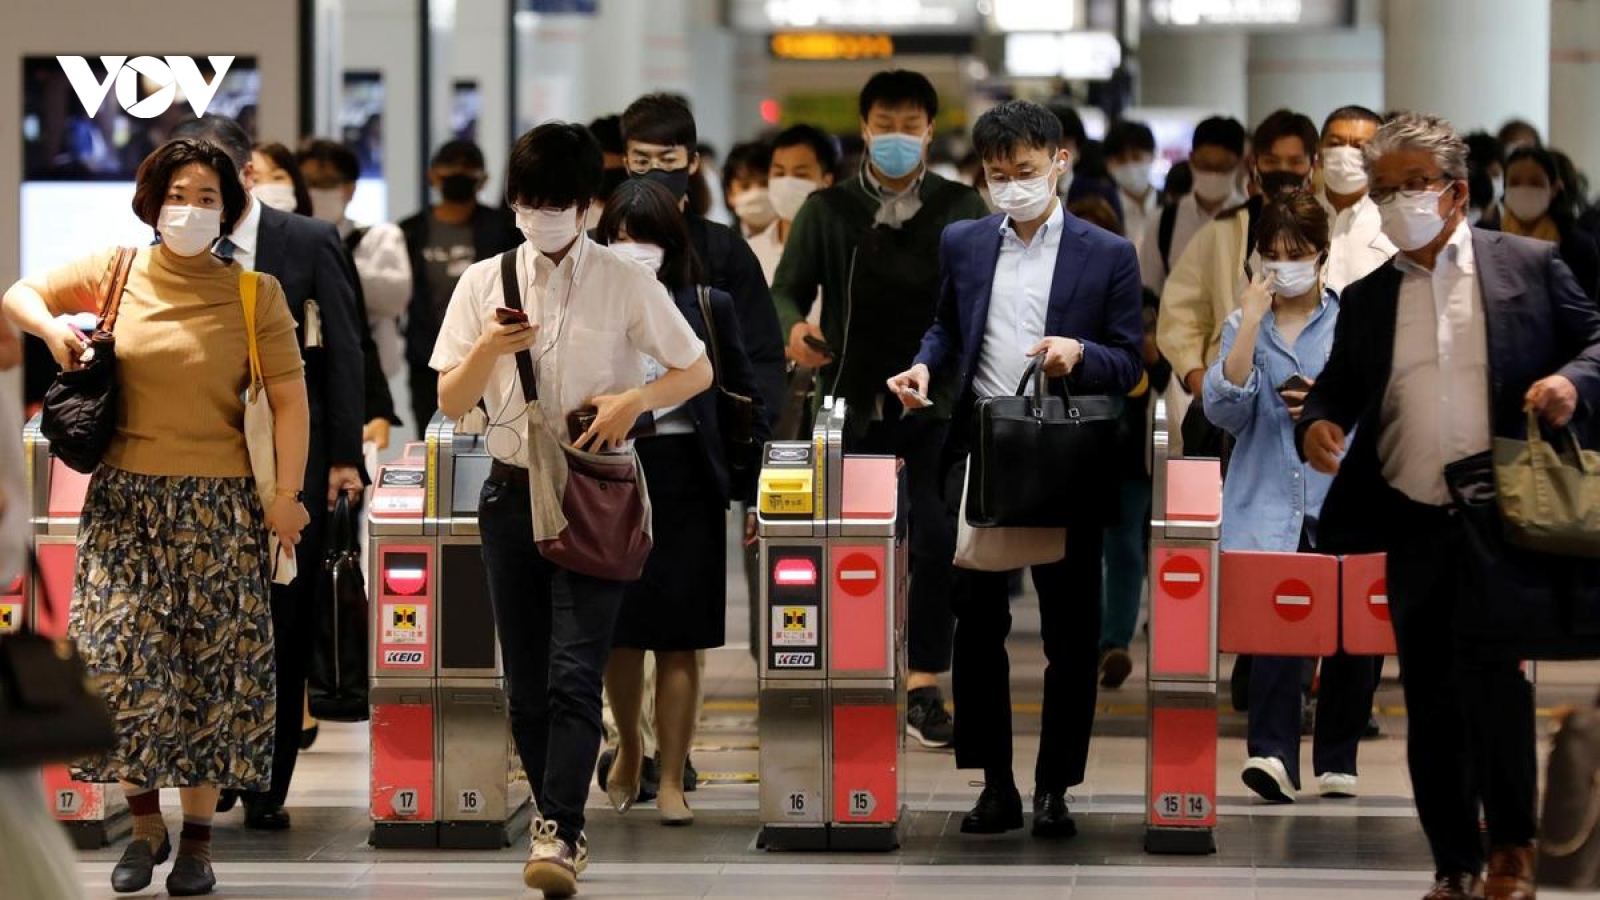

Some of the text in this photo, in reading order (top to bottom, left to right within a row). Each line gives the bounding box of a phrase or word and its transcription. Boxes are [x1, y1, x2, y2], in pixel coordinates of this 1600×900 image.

[387, 652, 422, 662] KEIO
[778, 655, 813, 664] KEIO
[59, 793, 74, 809] 17
[399, 792, 413, 808] 17
[462, 792, 477, 808] 16
[789, 794, 804, 810] 16
[853, 794, 868, 810] 15
[1164, 796, 1178, 812] 15
[1188, 796, 1203, 812] 14
